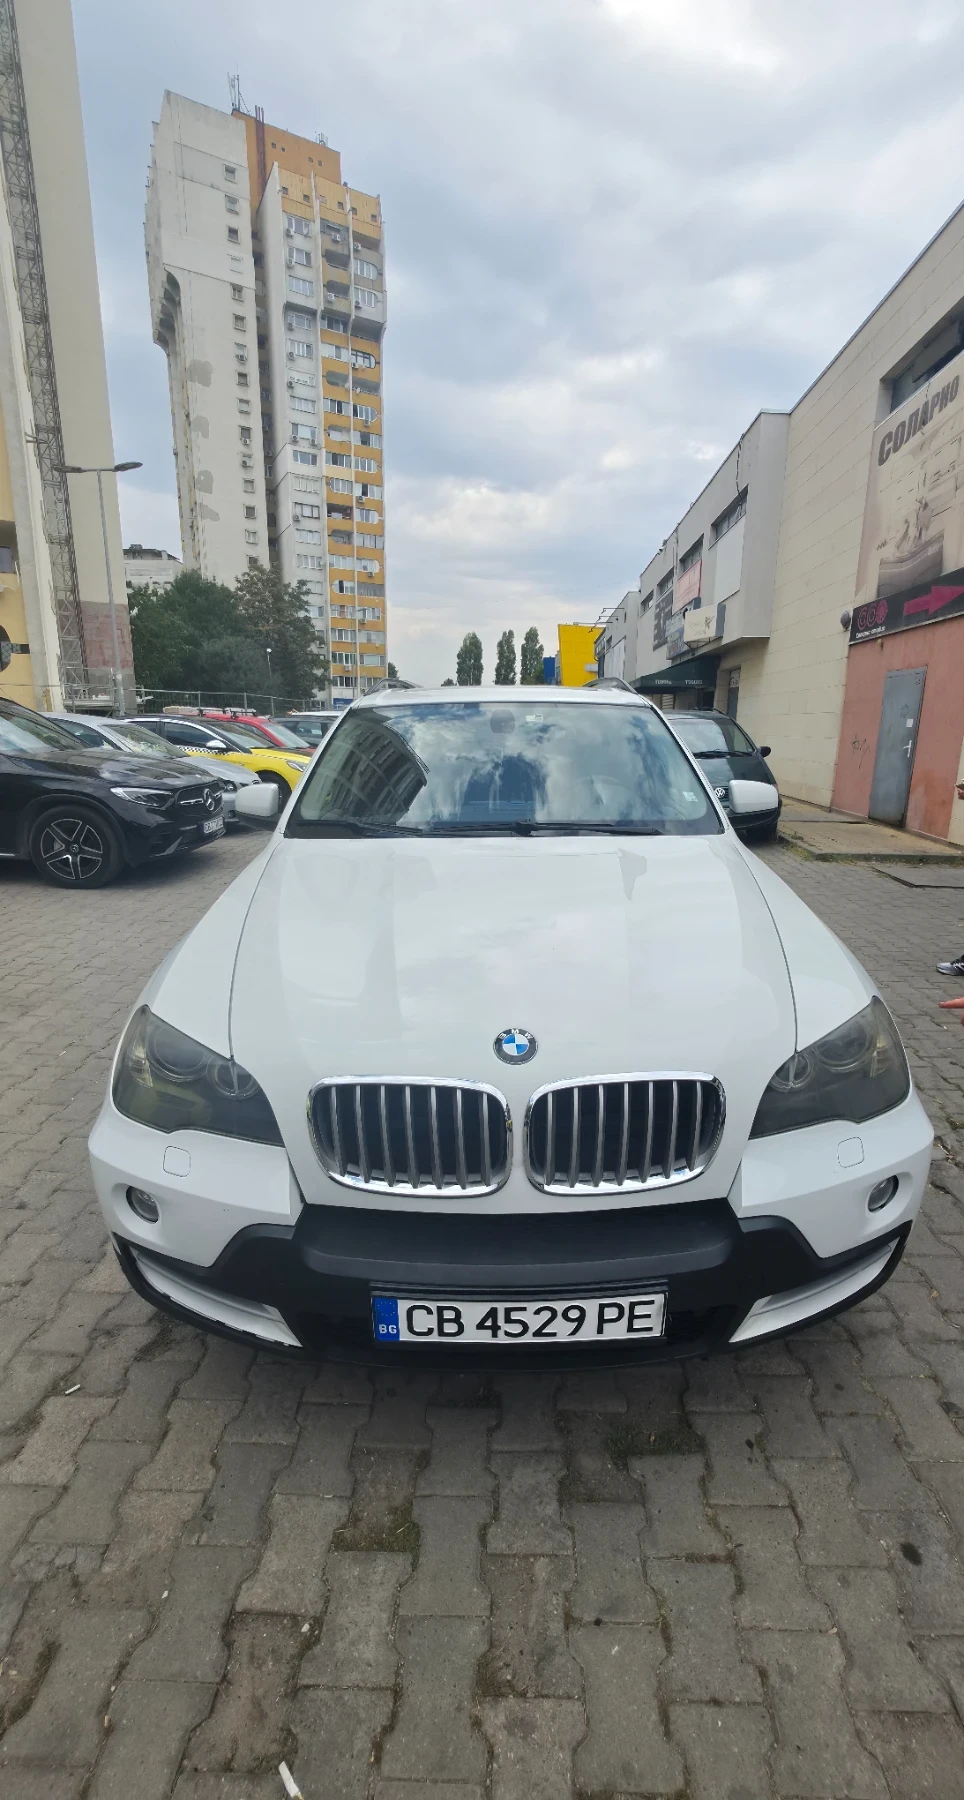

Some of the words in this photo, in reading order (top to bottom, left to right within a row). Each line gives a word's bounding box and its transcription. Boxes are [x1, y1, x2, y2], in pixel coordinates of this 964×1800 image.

[498, 1029, 534, 1040] BMW
[406, 1304, 465, 1337] CB
[475, 1304, 587, 1338] 4529
[596, 1300, 655, 1335] PE
[378, 1324, 397, 1335] BG
